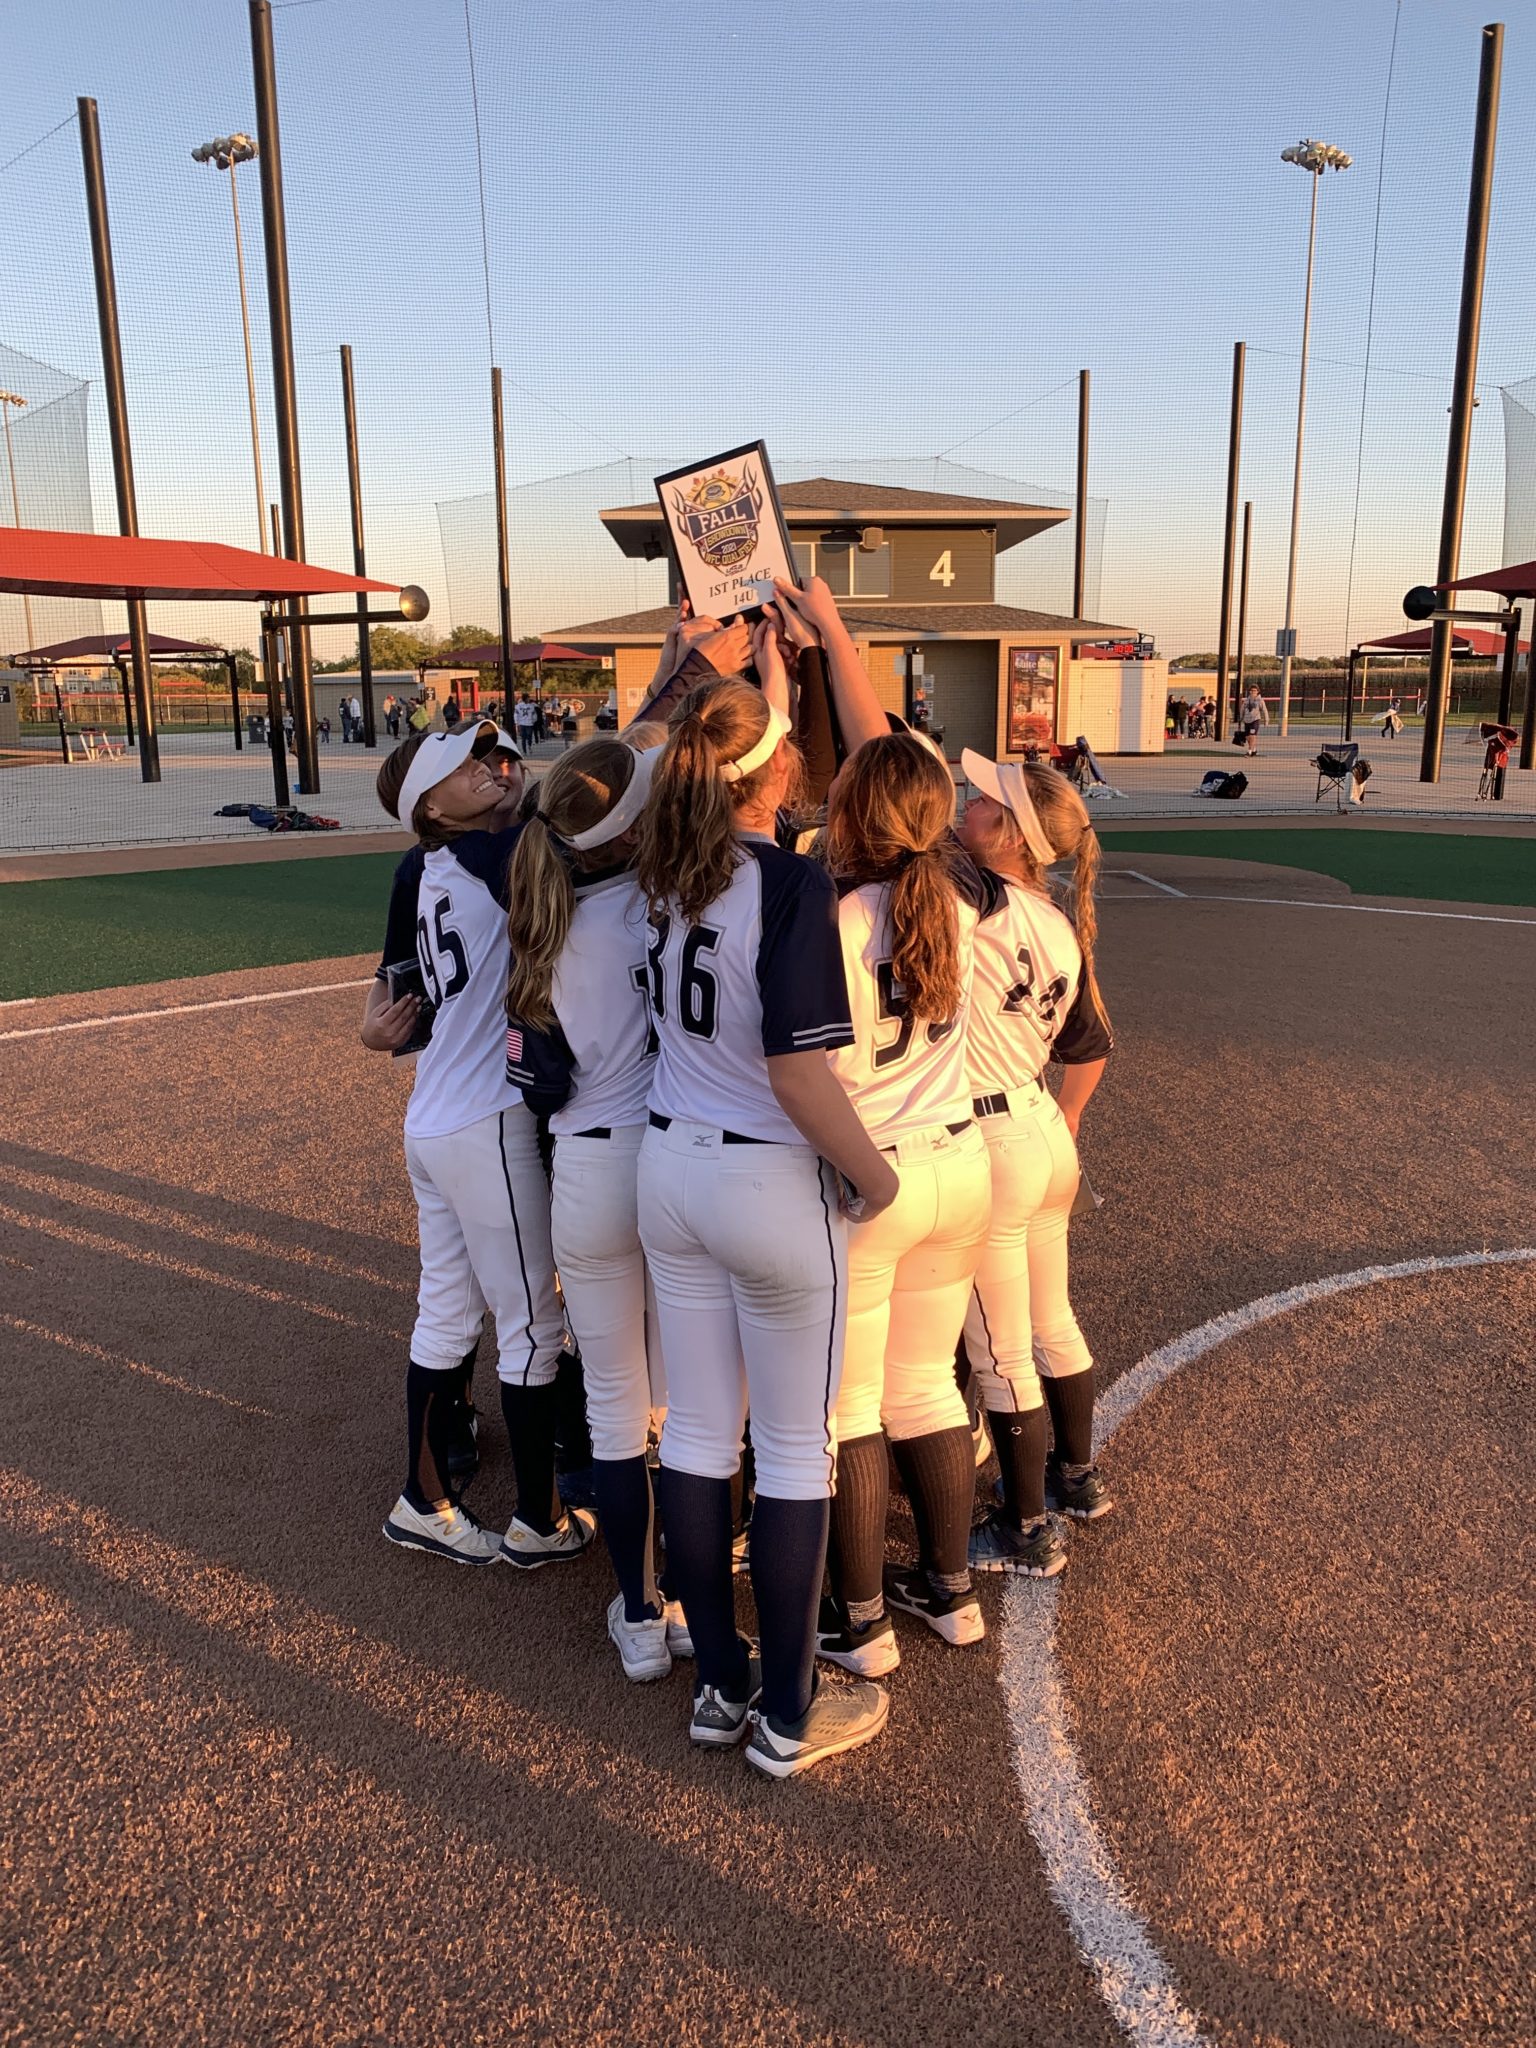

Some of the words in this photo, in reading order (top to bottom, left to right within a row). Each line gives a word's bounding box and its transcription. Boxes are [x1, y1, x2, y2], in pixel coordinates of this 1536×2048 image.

[698, 504, 746, 533] FALL
[707, 525, 747, 545] SHOWDOWN
[732, 568, 771, 590] PLACE
[929, 550, 955, 587] 4
[734, 589, 754, 605] 14U
[872, 957, 955, 1073] 5
